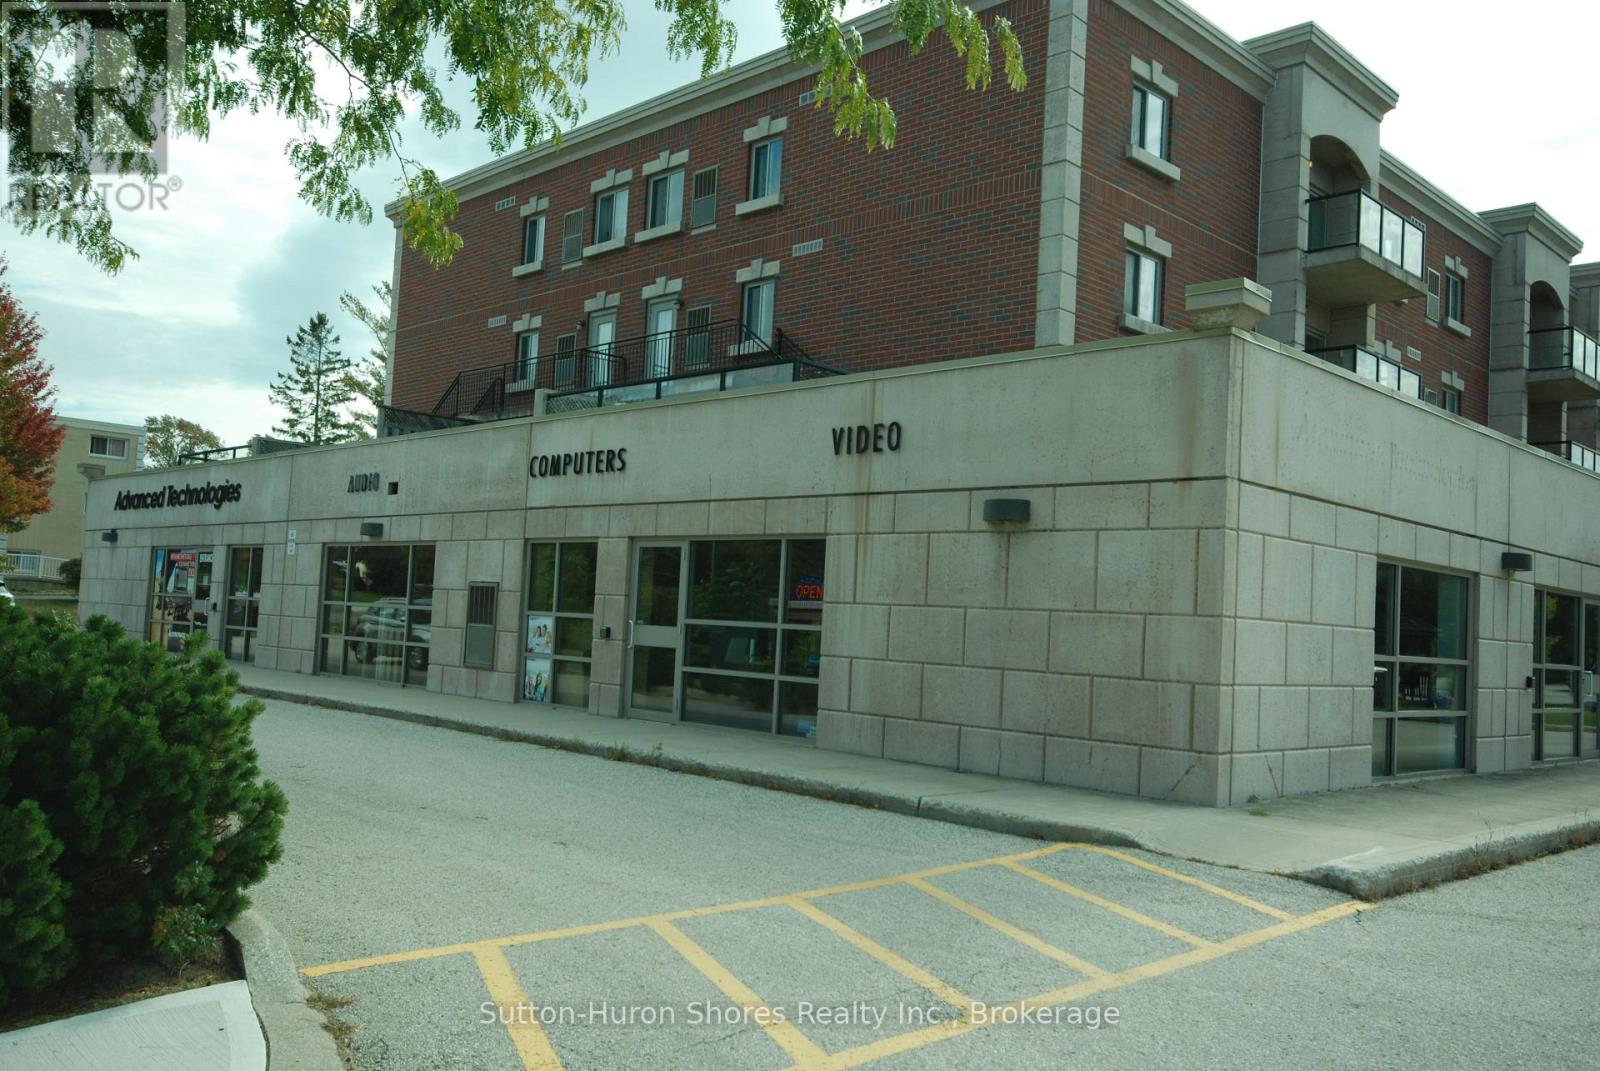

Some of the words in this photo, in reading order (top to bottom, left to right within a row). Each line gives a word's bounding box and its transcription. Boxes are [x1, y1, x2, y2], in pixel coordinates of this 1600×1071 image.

[831, 421, 902, 456] VIDEO
[529, 447, 627, 478] COMPUTERS
[114, 485, 167, 511] Advanced
[166, 479, 242, 510] Technologies
[347, 472, 380, 493] AUDIO
[795, 584, 824, 599] OPEN
